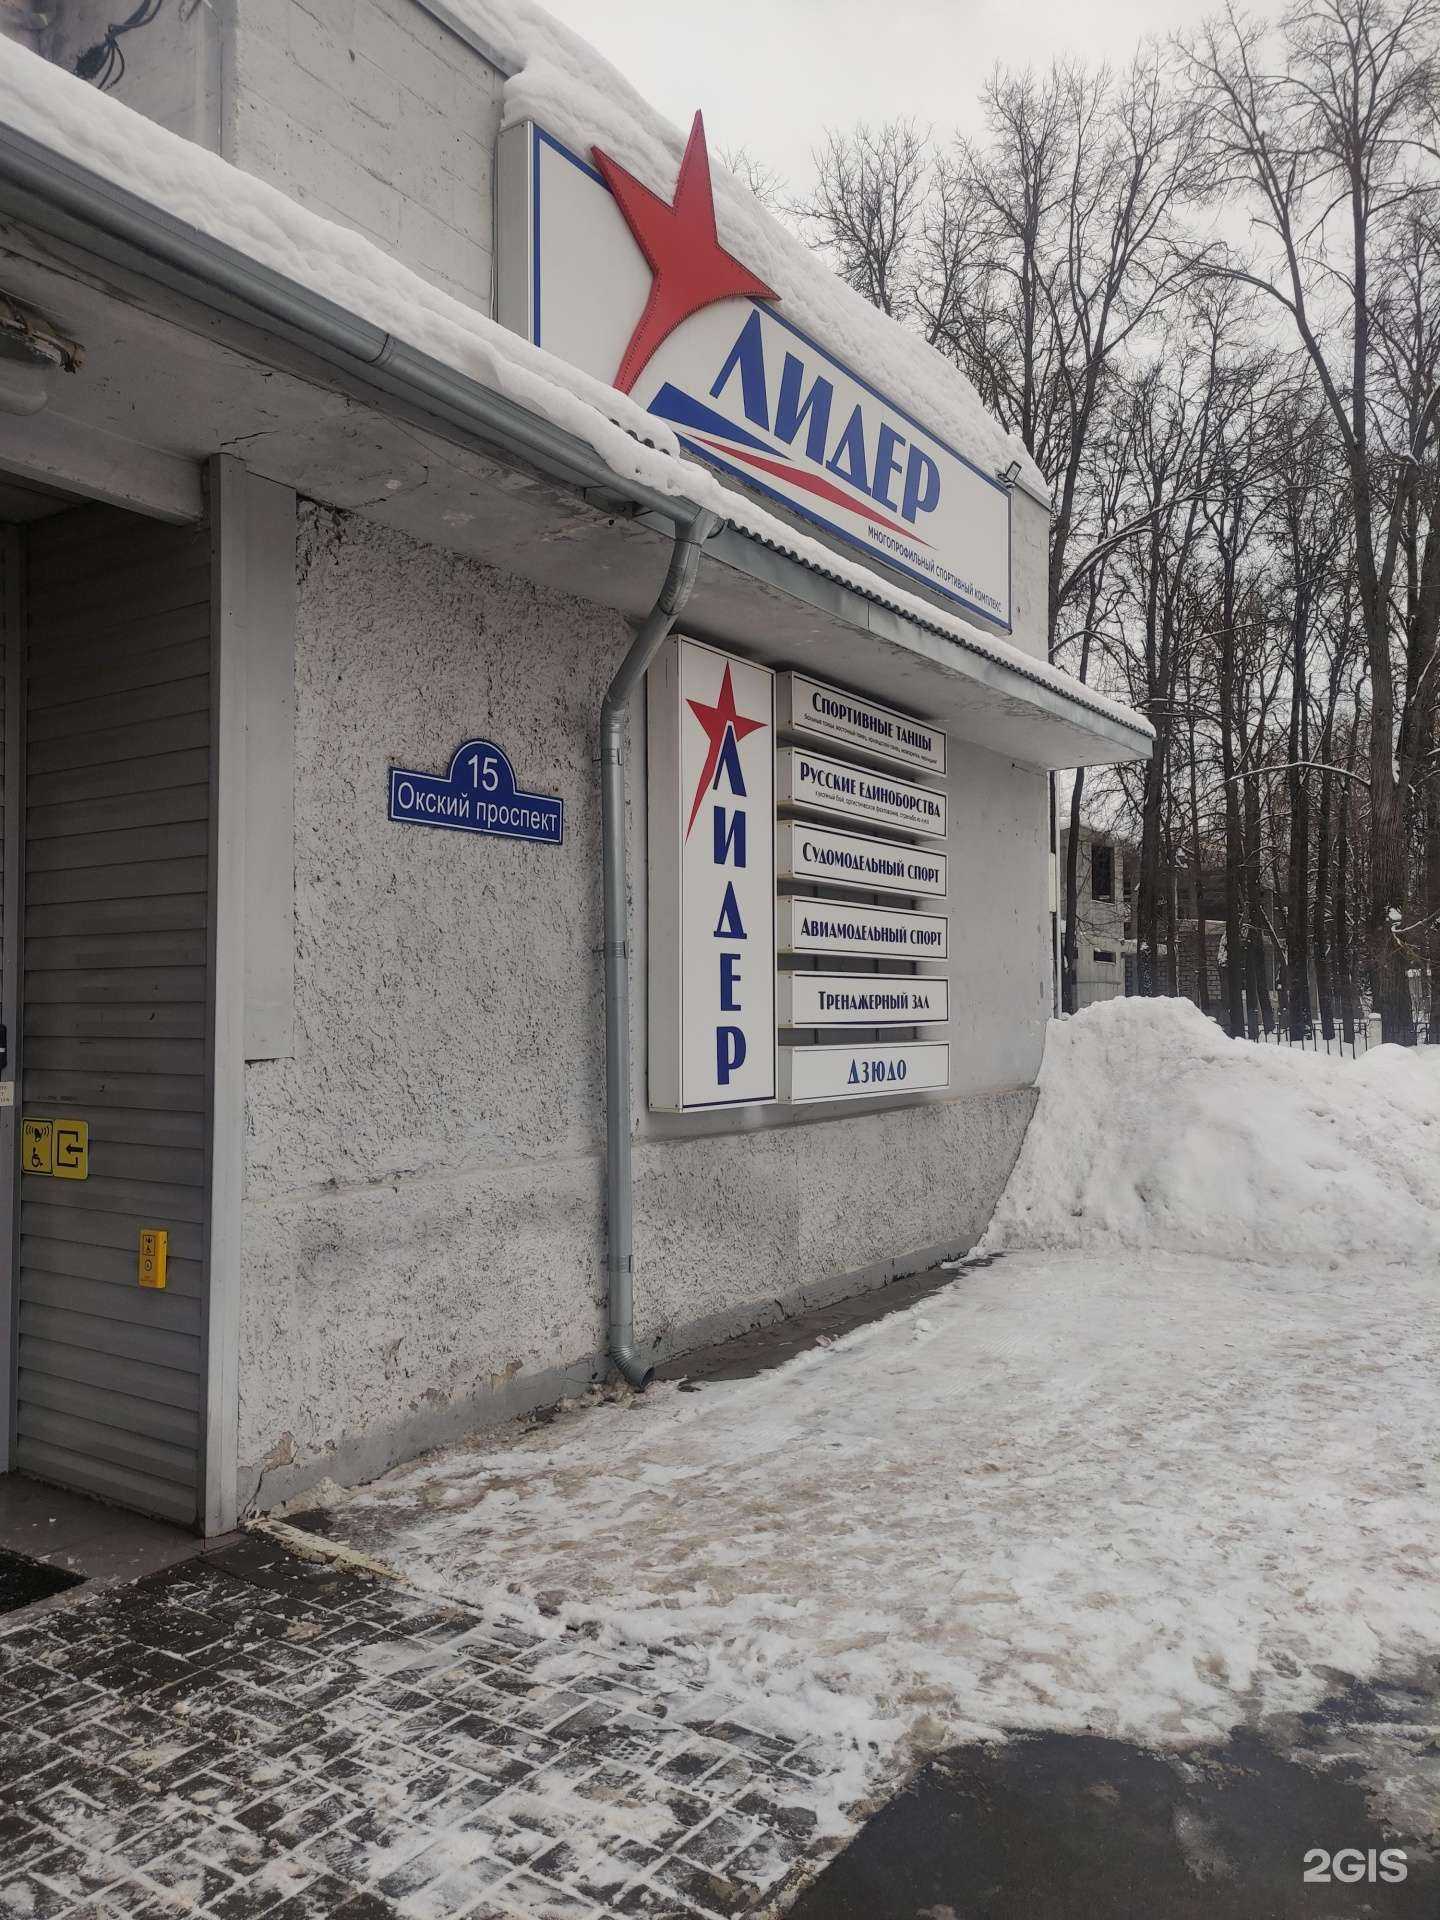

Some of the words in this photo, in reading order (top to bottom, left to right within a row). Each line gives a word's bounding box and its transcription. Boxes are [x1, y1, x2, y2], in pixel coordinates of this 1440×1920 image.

[709, 309, 940, 524] ЛИДЕР
[867, 525, 934, 574] МНОГОПРОФИЛЬНЫЙ
[935, 565, 974, 596] СПОРТИВНЫЙ
[468, 754, 499, 792] 15
[398, 782, 469, 819] Окский
[476, 801, 558, 832] проспект
[712, 725, 748, 1085] ЛИДЕР
[847, 1058, 907, 1084] ДЗЮДО
